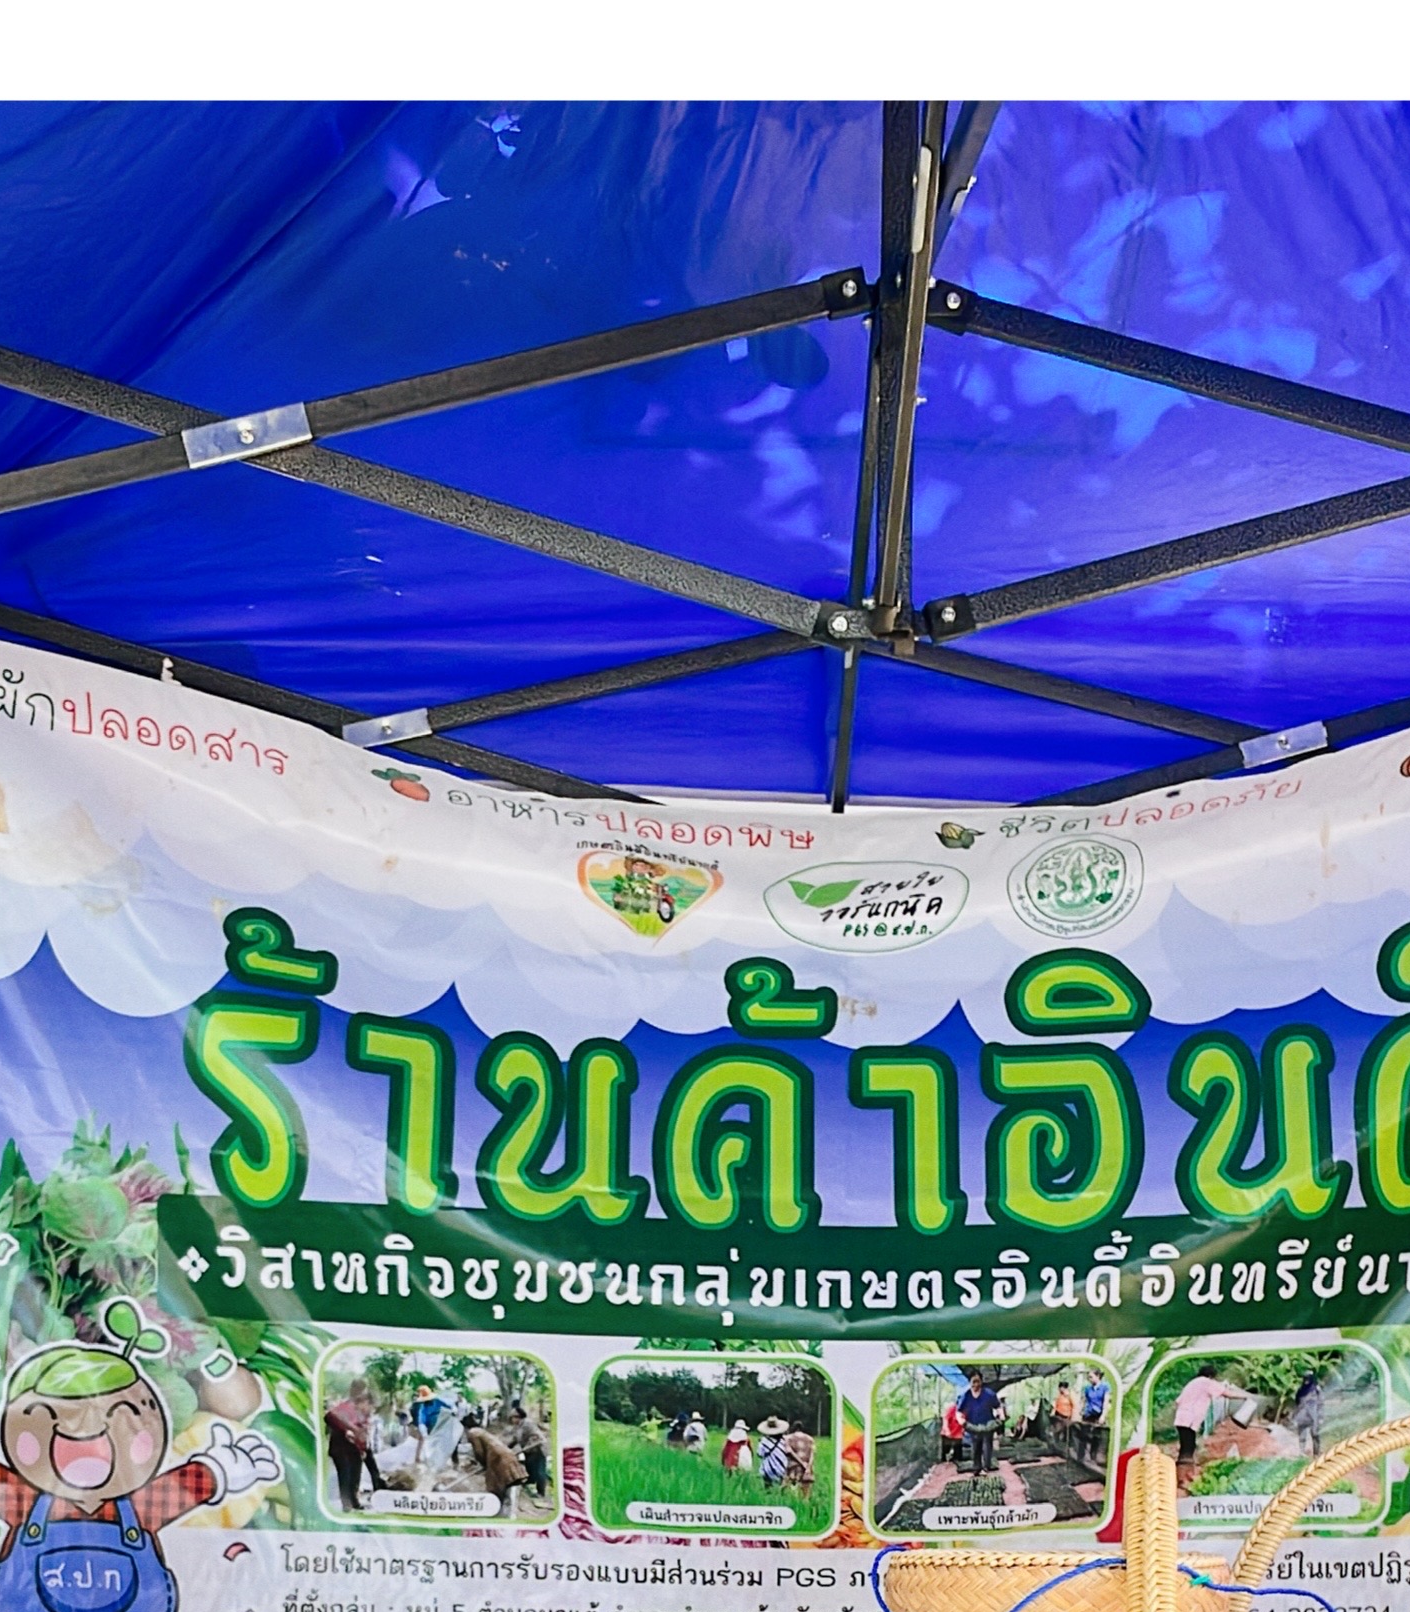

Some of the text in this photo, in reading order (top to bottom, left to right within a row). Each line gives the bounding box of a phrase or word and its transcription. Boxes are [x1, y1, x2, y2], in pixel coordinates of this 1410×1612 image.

[448, 786, 816, 851] อาหารปลอดพิษ
[999, 775, 1304, 838] ชีวิตปลอดภัย
[43, 1560, 121, 1592] ส.ป.ก
[280, 1543, 764, 1588] โดยใช้มาตรฐานการรับรองแบบมีส่วนร่วม
[776, 1567, 837, 1588] PGS
